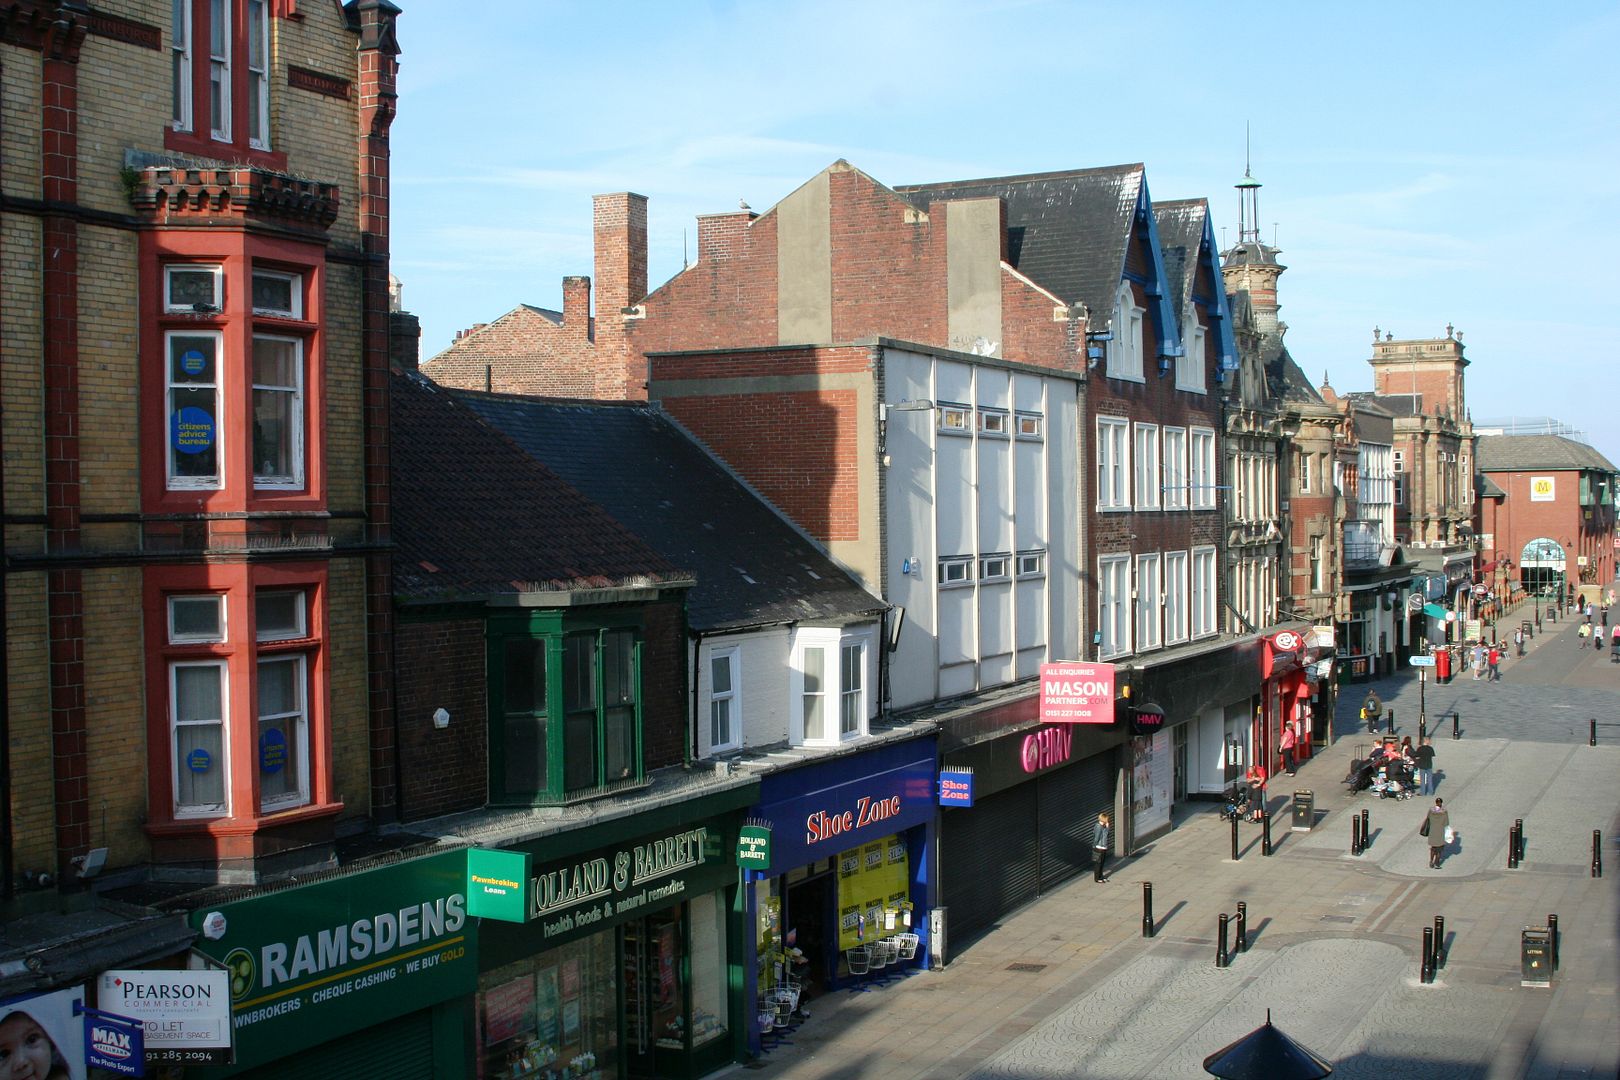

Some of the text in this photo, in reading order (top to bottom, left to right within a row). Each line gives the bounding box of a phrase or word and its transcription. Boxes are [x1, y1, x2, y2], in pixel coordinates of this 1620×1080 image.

[1045, 668, 1095, 676] ALL ENQUIRIES
[1045, 681, 1108, 696] MASON
[1136, 714, 1163, 725] HMV
[942, 780, 969, 790] Shoe
[941, 789, 969, 800] Zone
[807, 795, 900, 845] Shoe Zone
[740, 836, 766, 847] HOLLAND
[614, 851, 630, 892] &
[634, 827, 707, 880] BARRETT
[740, 850, 766, 861] BARRETT
[472, 875, 519, 889] Pawnbroking
[484, 885, 506, 895] Loans
[543, 879, 685, 938] health foods & natural remedies
[261, 893, 465, 988] RAMSDENS
[312, 981, 352, 1004] CHEQUE
[355, 967, 396, 992] CASHING
[406, 960, 421, 974] WE
[422, 955, 440, 970] BUY
[440, 946, 465, 962] GOLD
[123, 981, 211, 999] PEARSON
[124, 1000, 211, 1008] COMMERCIAL
[144, 1021, 184, 1032] TO LET
[93, 1027, 131, 1050] MAX
[144, 1031, 211, 1039] BASEMENT SPACE
[162, 1051, 182, 1061] 285
[185, 1051, 212, 1061] 2094
[90, 1056, 135, 1073] The Photo Expert
